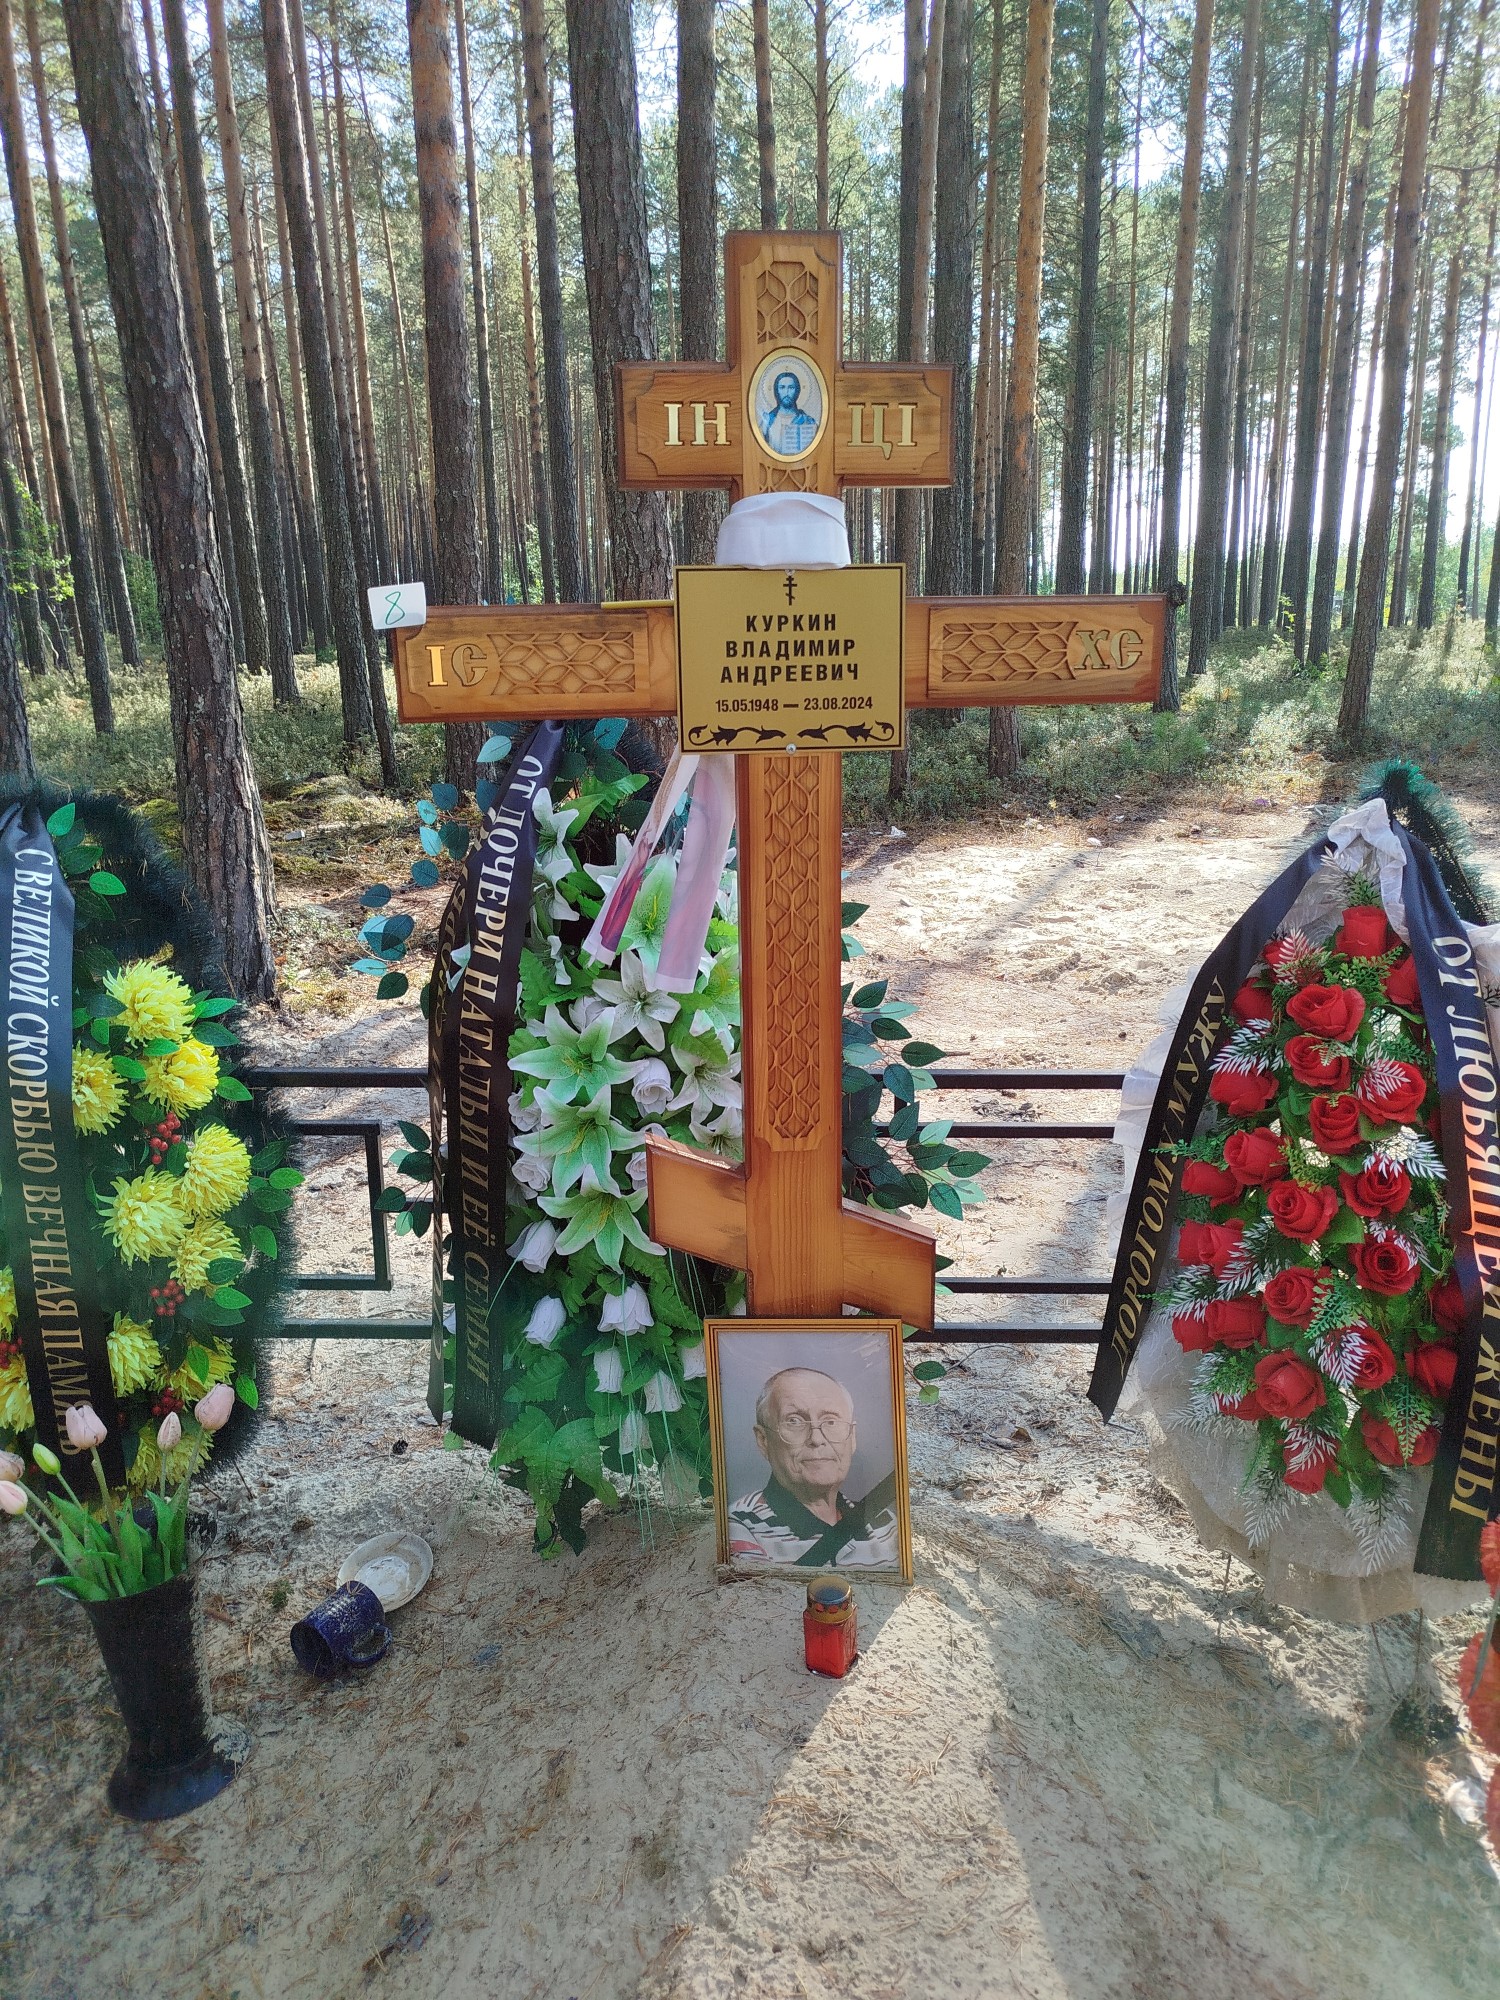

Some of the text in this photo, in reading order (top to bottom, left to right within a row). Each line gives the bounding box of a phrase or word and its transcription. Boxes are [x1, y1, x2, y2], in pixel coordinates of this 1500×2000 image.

[385, 591, 405, 625] 8
[746, 614, 836, 632] КУРКИН
[720, 663, 858, 686] АНДРЕЕВИЧ
[726, 639, 855, 660] ВЛАДИМИР
[715, 698, 779, 712] 15.05.1948
[803, 696, 873, 711] 23.08.2024
[14, 848, 54, 866] С
[9, 867, 60, 1007] ВЕЛИКОЙ
[1431, 936, 1482, 998] ОТ
[7, 1012, 58, 1174] СКОРБЬЮ
[459, 755, 543, 1386] ОТ ДОЧЕРИ НАТАЛЬИ И ЕЁ СЕМЬИ
[1111, 975, 1227, 1381] ДОРОГОМУ МУЖУ
[22, 1182, 79, 1319] ВЕЧНАЯ
[1449, 1334, 1500, 1523] ЖЕНЫ
